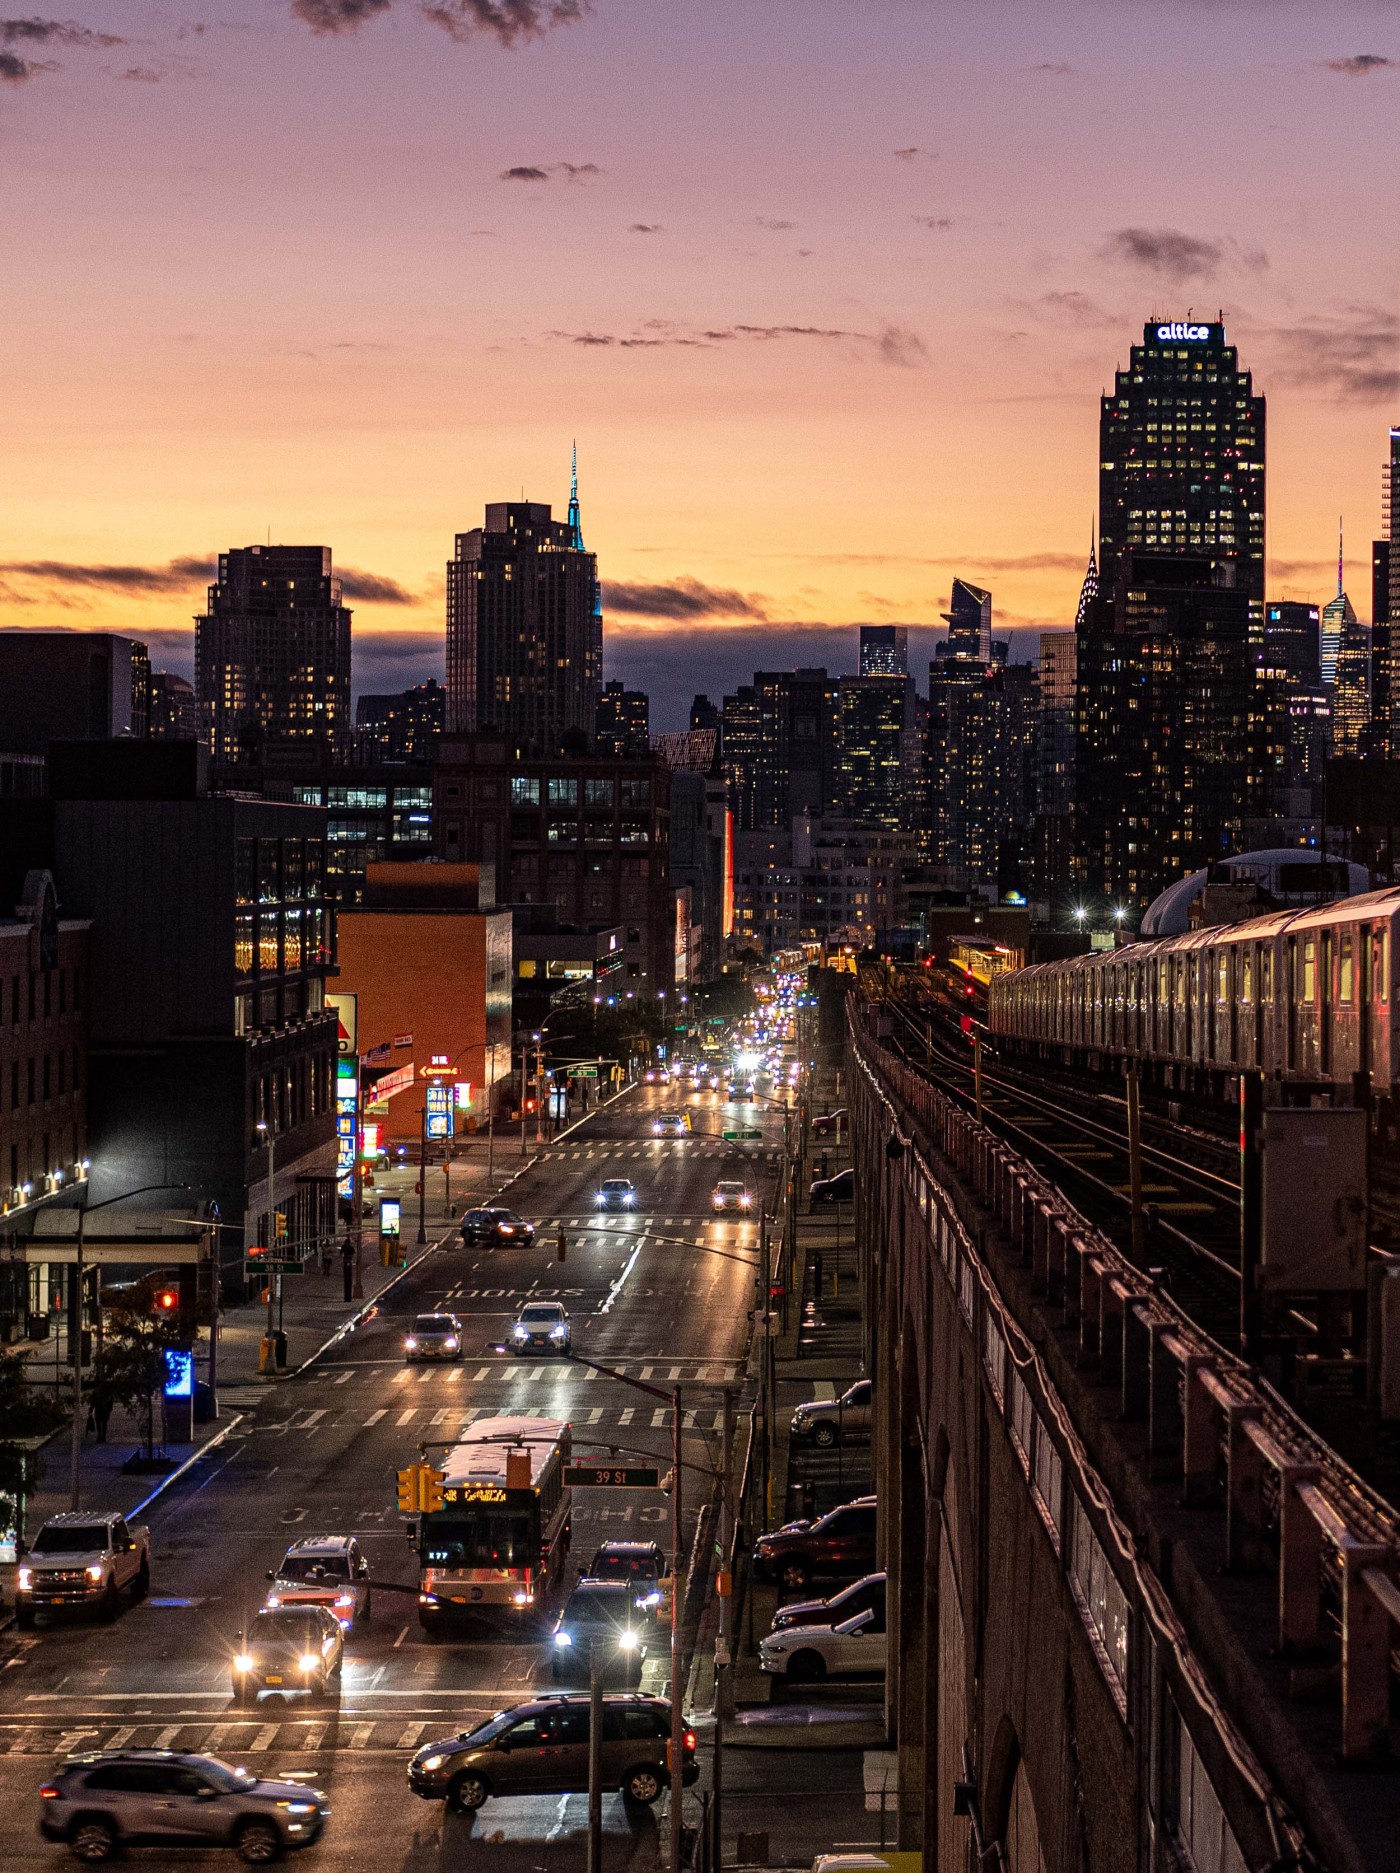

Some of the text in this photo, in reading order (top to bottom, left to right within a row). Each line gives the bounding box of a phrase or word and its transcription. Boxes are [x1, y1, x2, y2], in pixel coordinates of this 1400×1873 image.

[1158, 323, 1209, 339] altice
[265, 1264, 284, 1272] 38 St
[595, 1472, 626, 1484] 39 St
[806, 1483, 812, 1491] P
